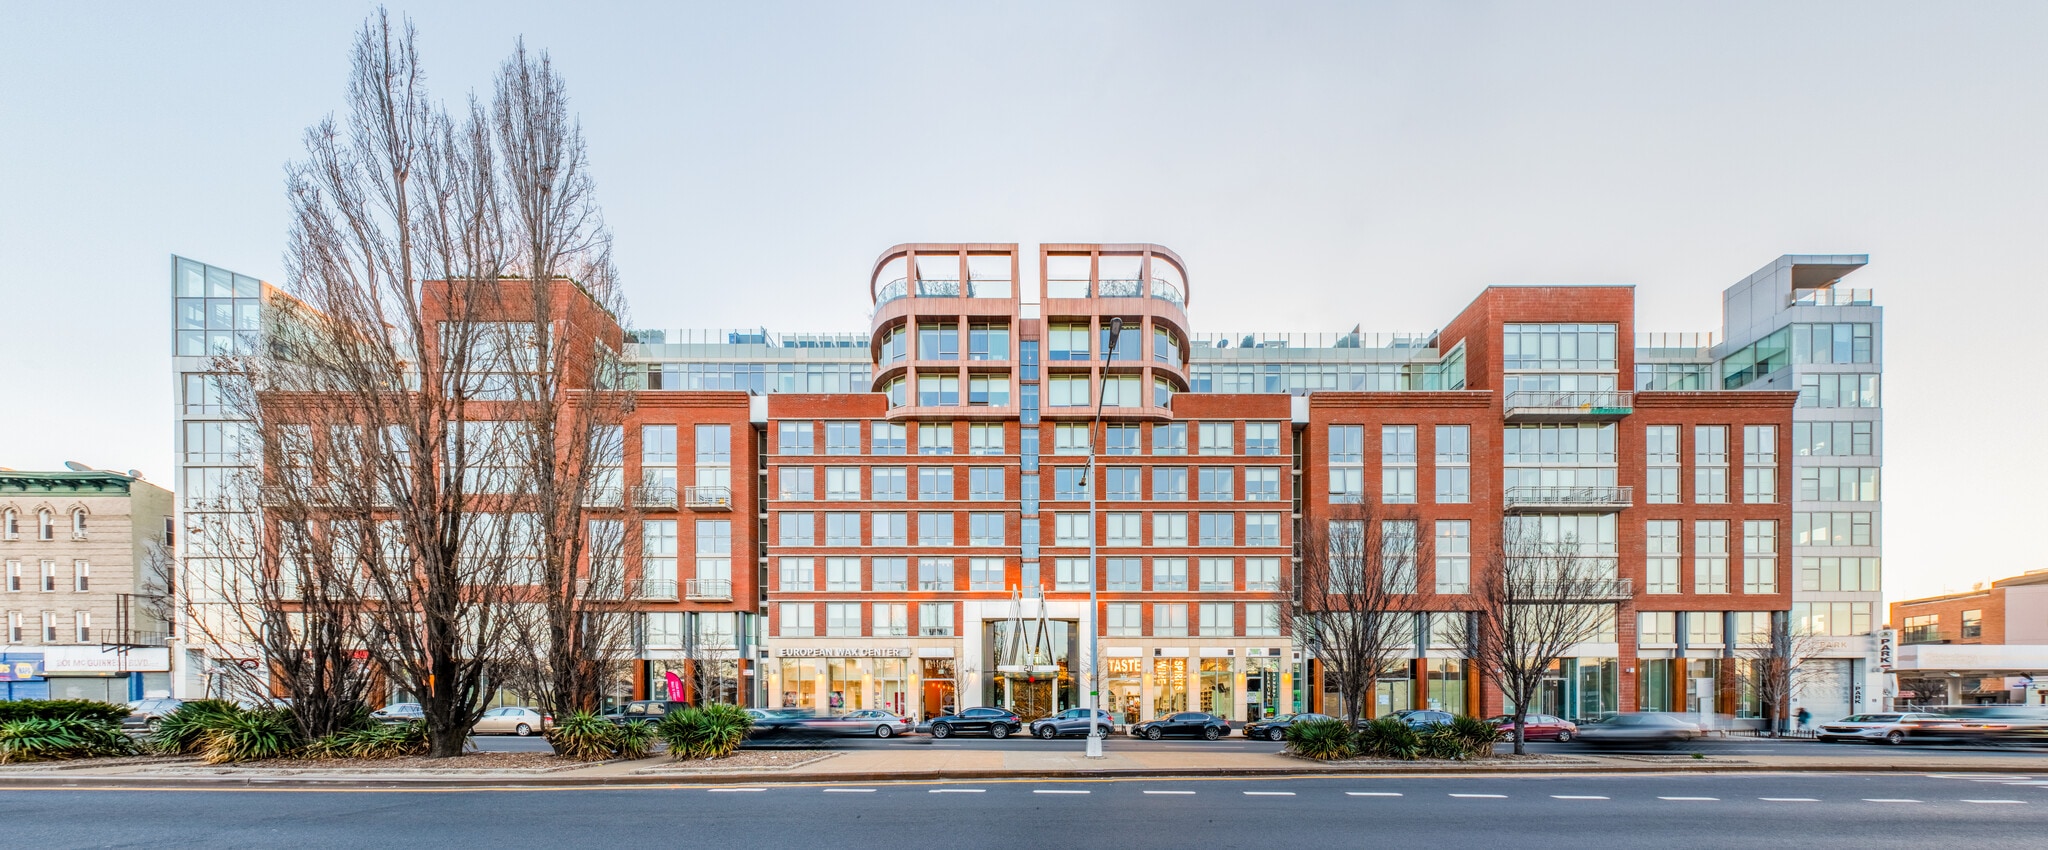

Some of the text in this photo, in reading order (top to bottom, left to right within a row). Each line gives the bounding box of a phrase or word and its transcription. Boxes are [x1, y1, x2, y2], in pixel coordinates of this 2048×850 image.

[781, 647, 900, 657] EUROPEAN WAX CENTER
[1820, 641, 1848, 649] PARK
[1880, 639, 1890, 663] PARK
[1108, 659, 1142, 672] TASTE
[1156, 660, 1168, 685] WINE
[1174, 660, 1184, 691] SPIRITS
